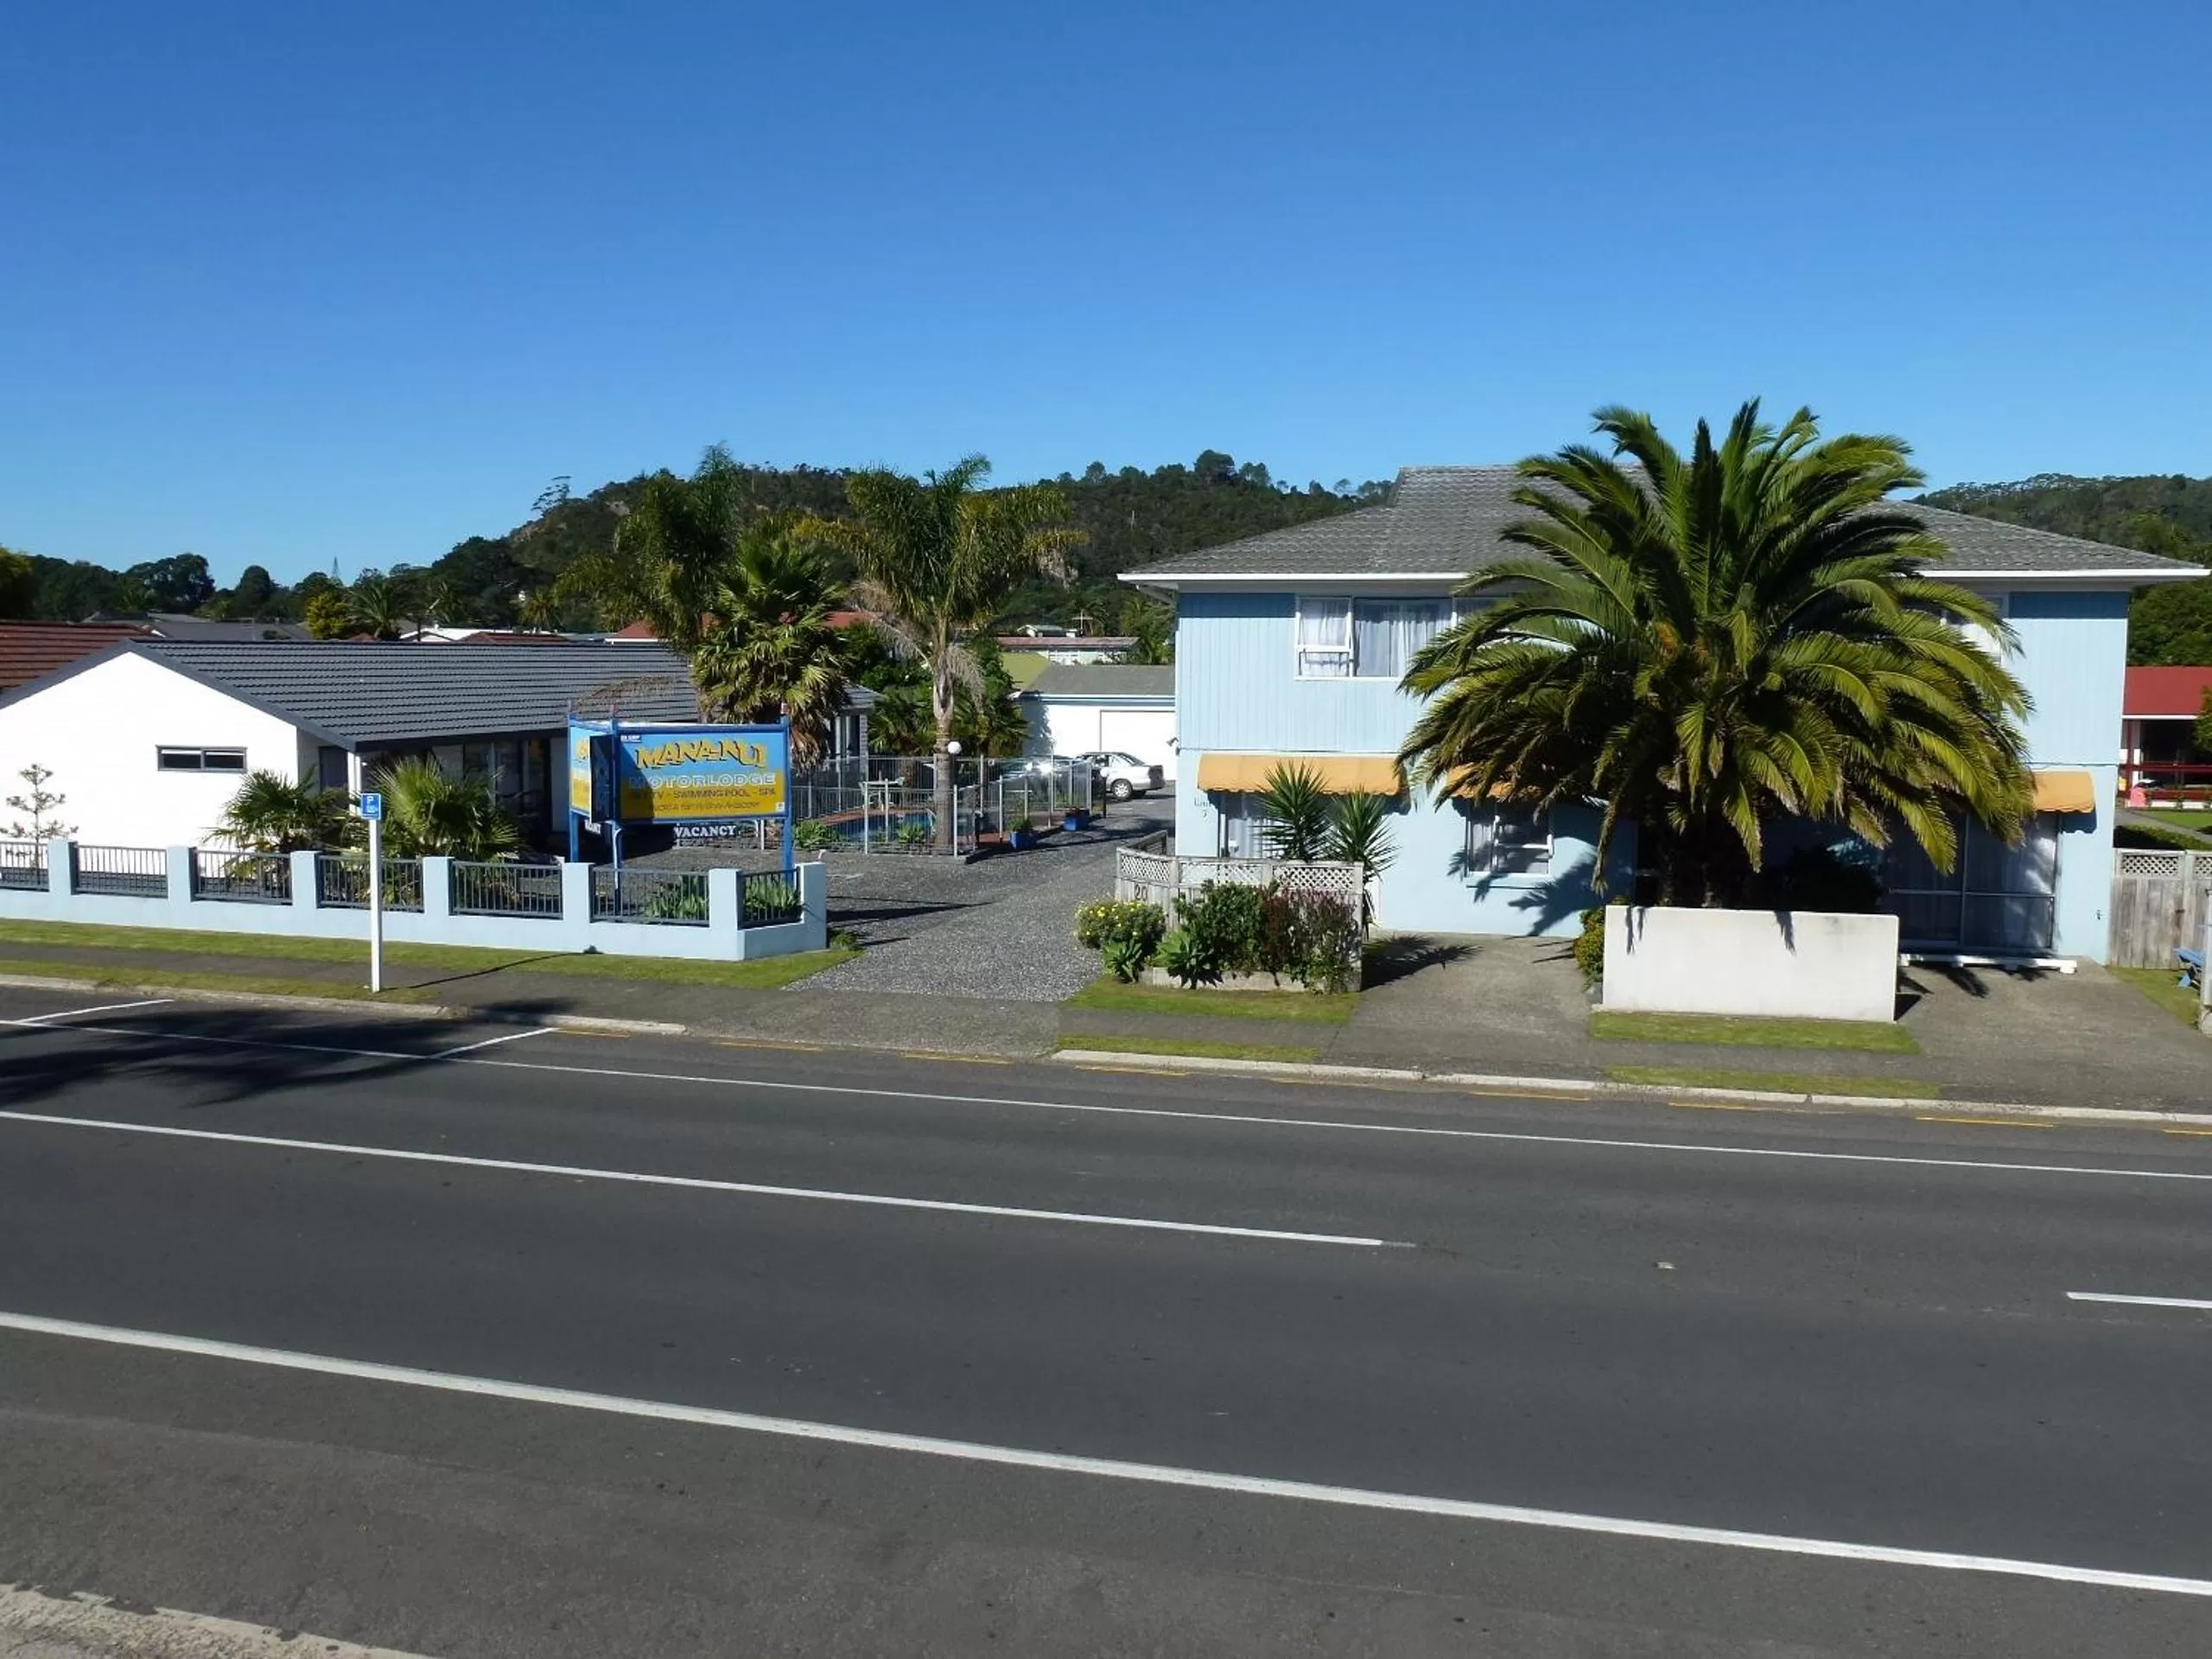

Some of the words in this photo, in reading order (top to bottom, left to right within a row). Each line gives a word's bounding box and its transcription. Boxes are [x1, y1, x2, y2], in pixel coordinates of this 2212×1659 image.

[629, 773, 776, 789] MOTORLODGE
[673, 789, 722, 799] SWIMMING
[723, 787, 750, 797] POOL
[674, 825, 736, 837] VACANCY
